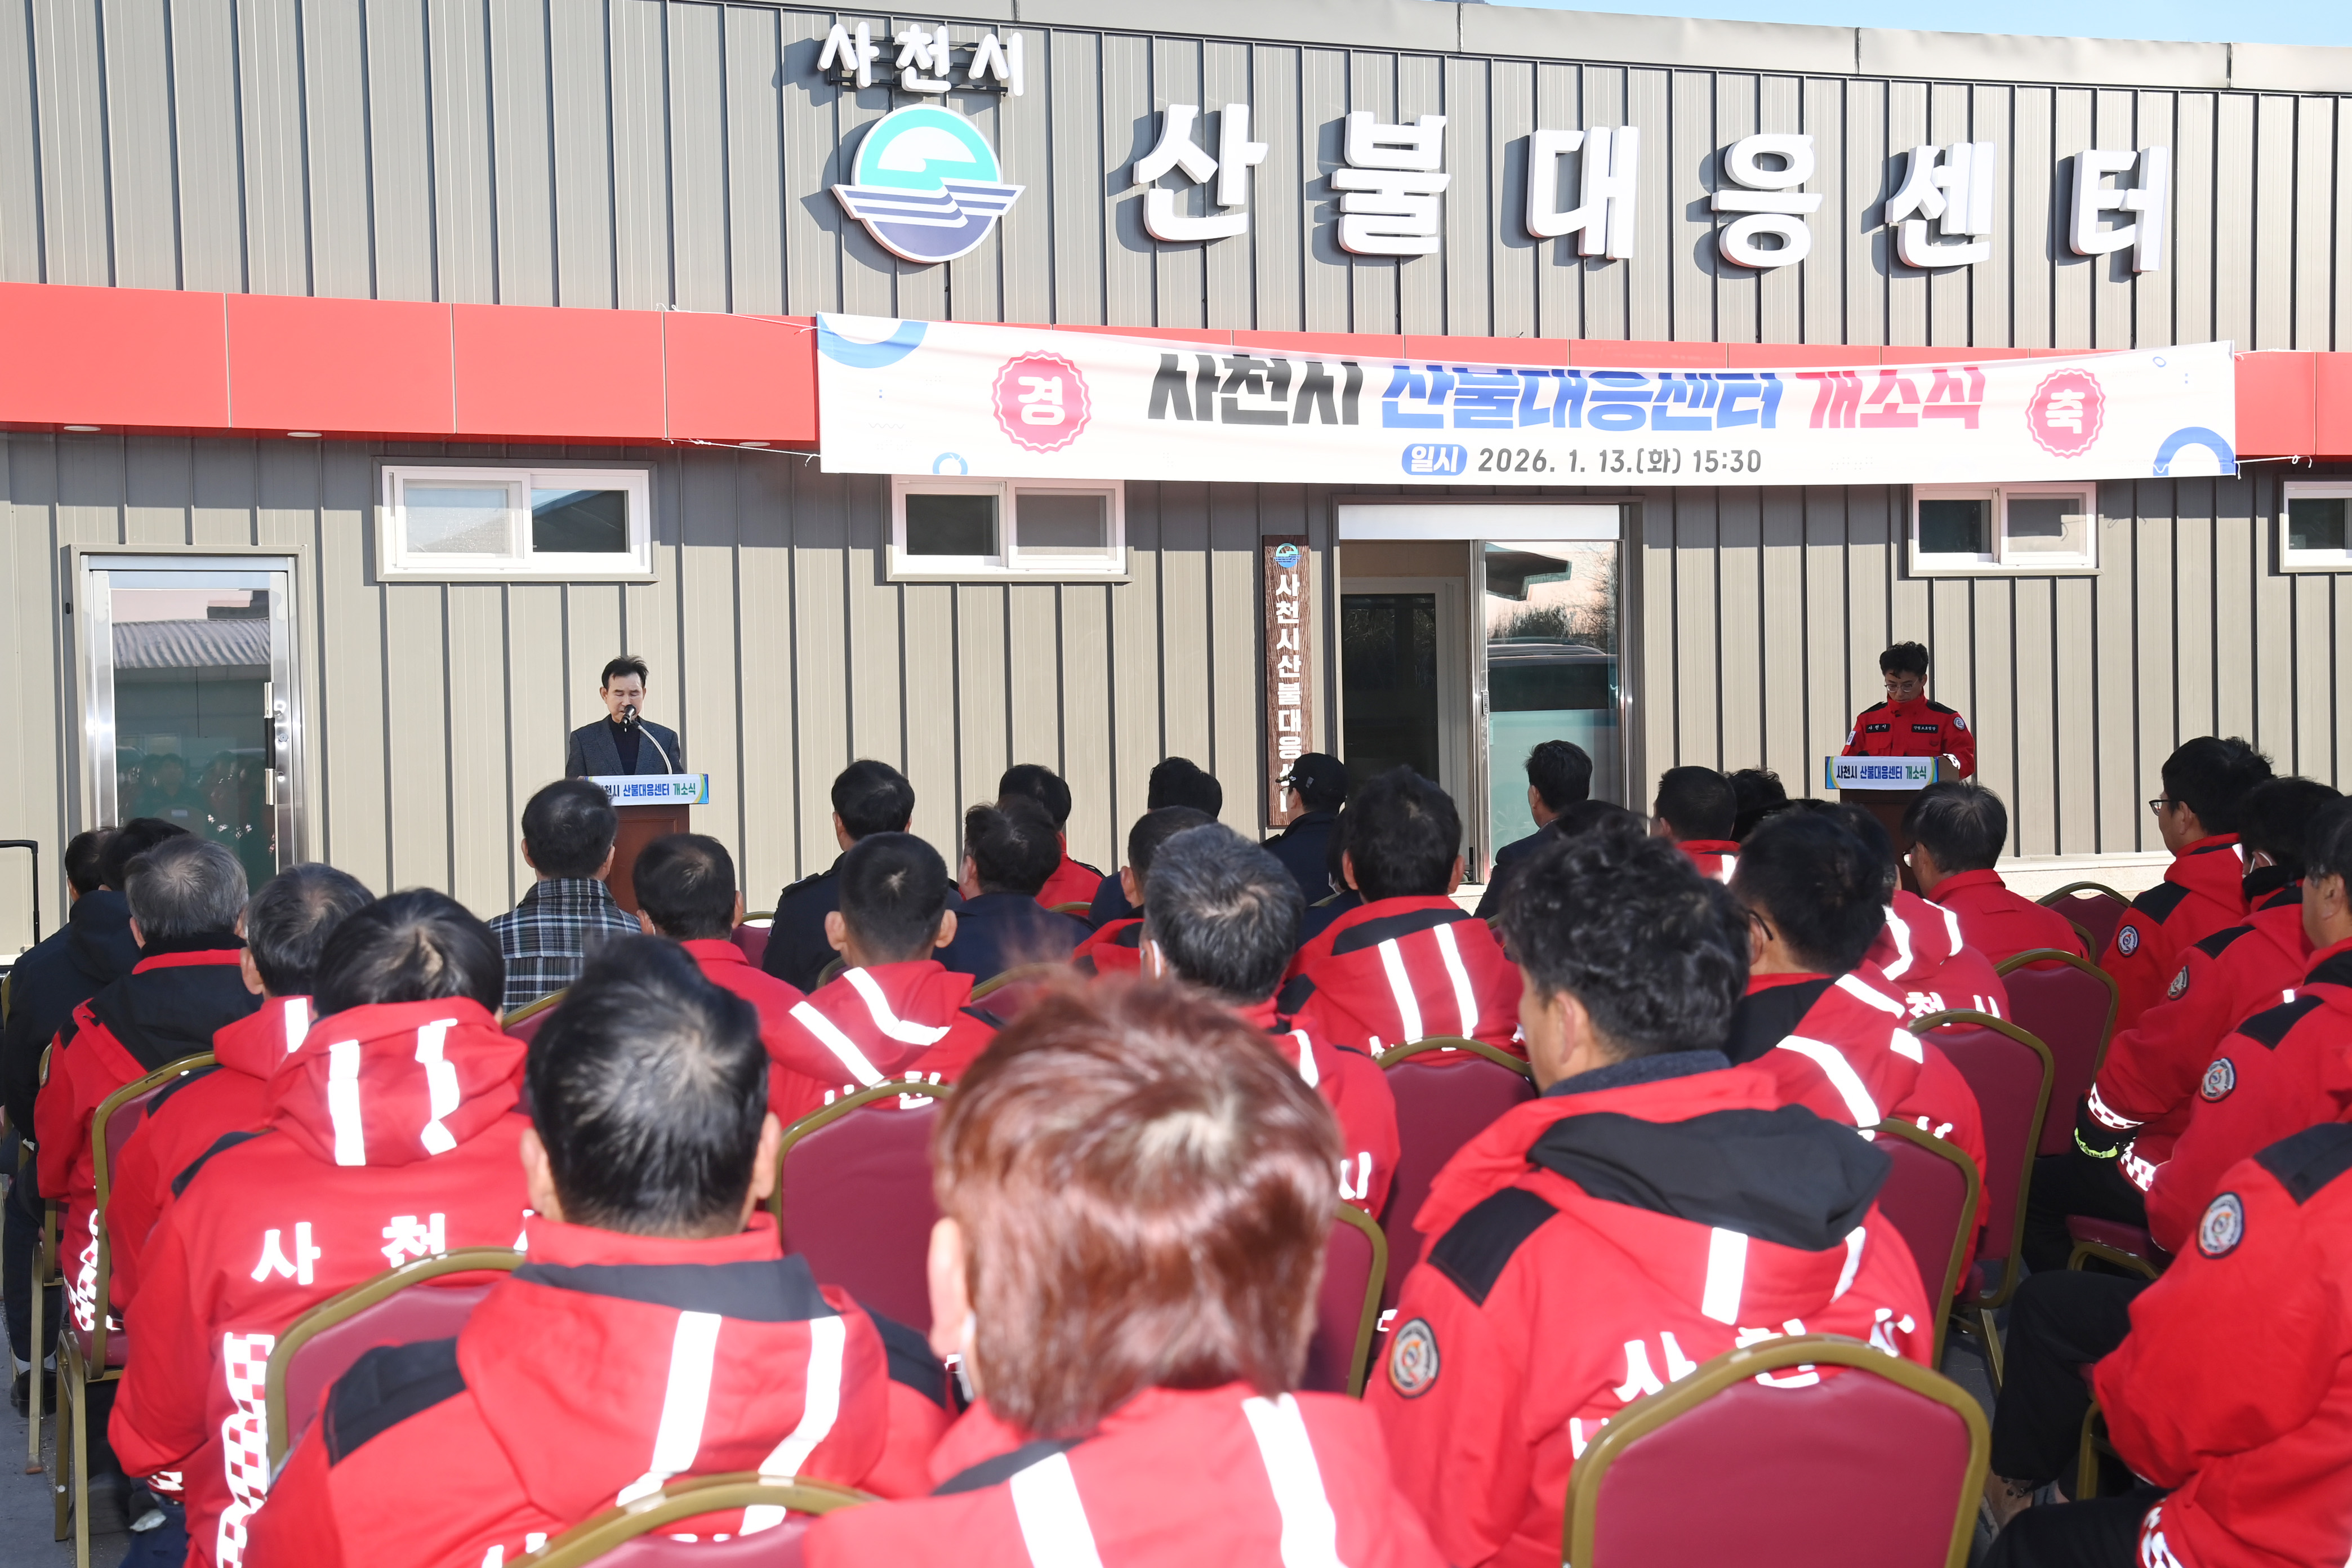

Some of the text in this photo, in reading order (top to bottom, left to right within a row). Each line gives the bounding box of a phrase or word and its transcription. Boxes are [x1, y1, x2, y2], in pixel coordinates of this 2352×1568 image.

[817, 20, 1024, 97] 사천시
[1133, 103, 2169, 273] 산불대응센터
[1017, 376, 1066, 426] 경
[1148, 353, 1986, 431] 사천시 산불대응센터 개소식
[2045, 388, 2086, 434] 축
[1410, 446, 1458, 473] 일시
[1478, 448, 1556, 473] 2026.
[1569, 448, 1586, 474] 1.
[1692, 448, 1762, 473] 15:30
[602, 782, 696, 798] 천시 산불대응센터 개소식
[1836, 765, 1927, 779] 사천시 산불대응센터 개소식
